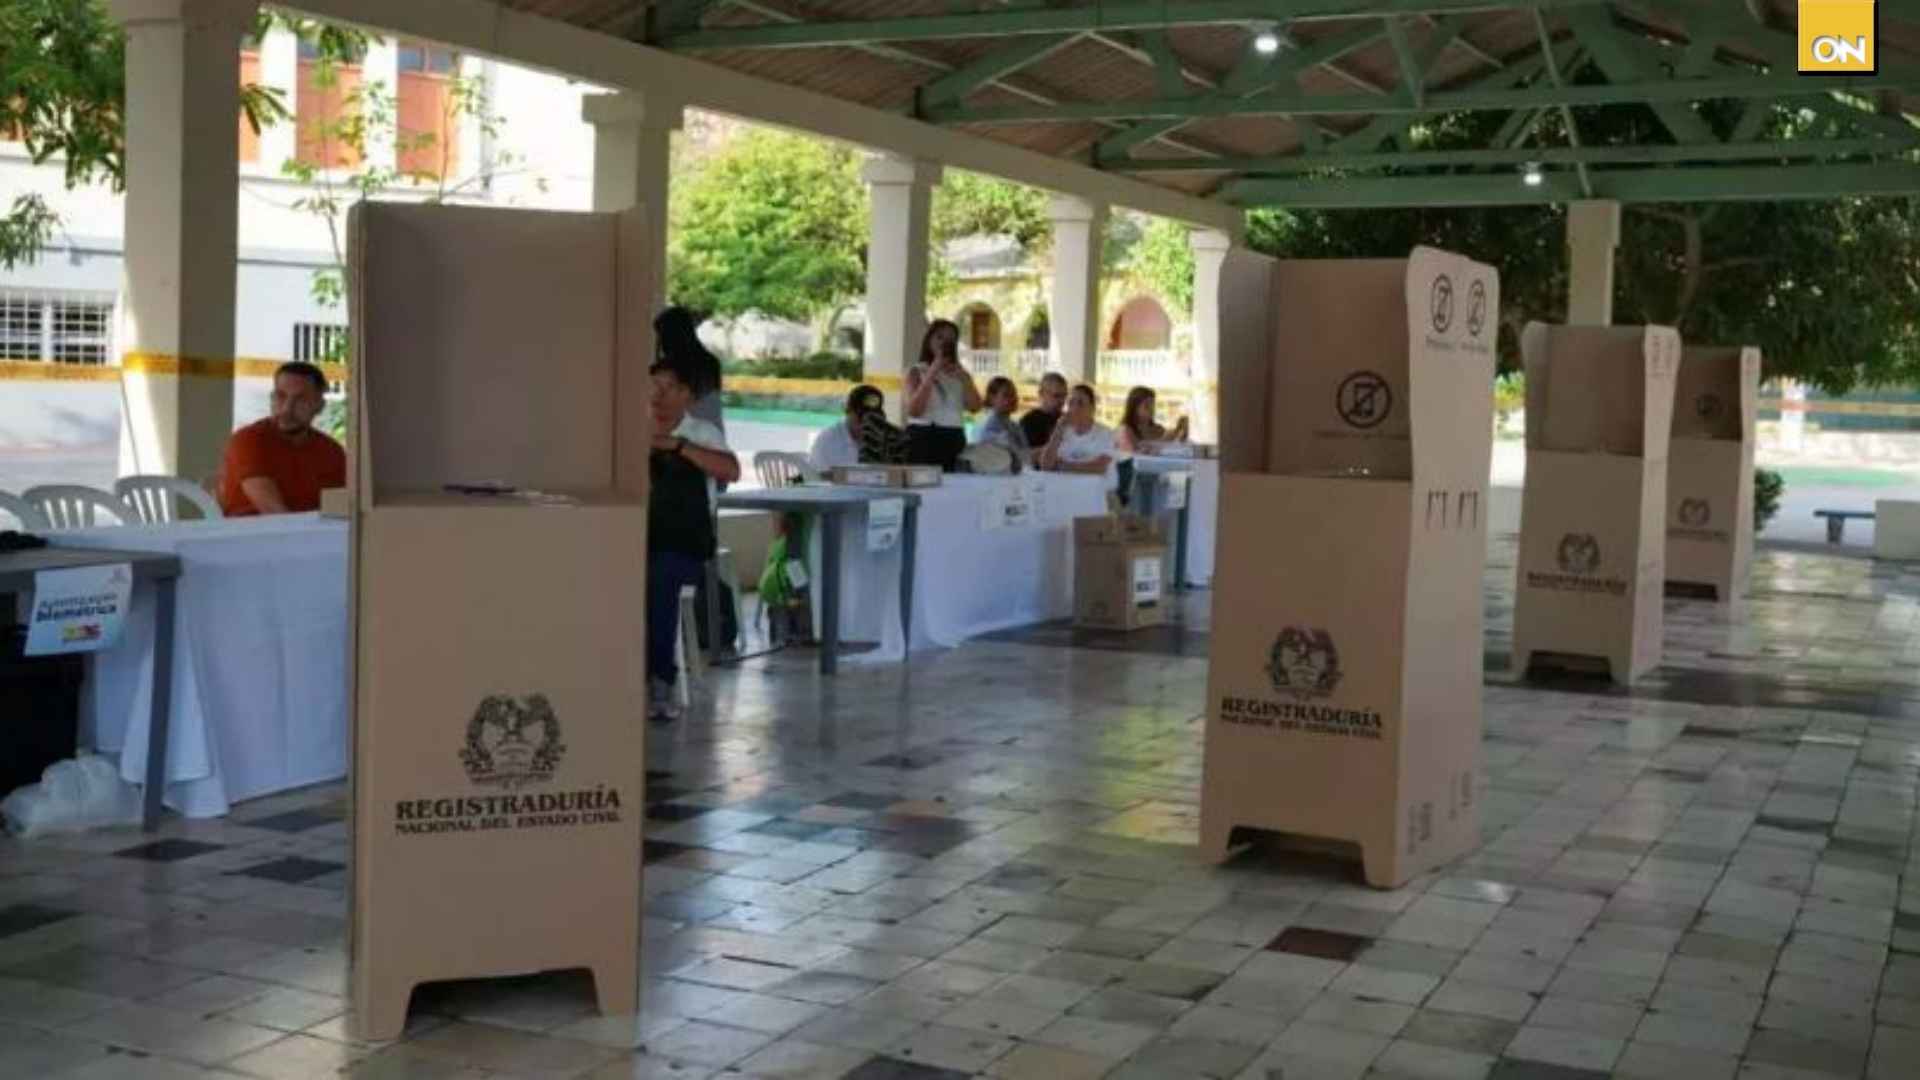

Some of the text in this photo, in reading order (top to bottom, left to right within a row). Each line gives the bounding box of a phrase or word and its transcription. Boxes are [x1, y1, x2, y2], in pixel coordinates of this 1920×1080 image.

[1221, 697, 1382, 729] REGISTRADURÍA
[395, 784, 621, 820] REGISTRADURÍA
[395, 811, 621, 836] NACIONAL DEL ESTADO CIVIL
